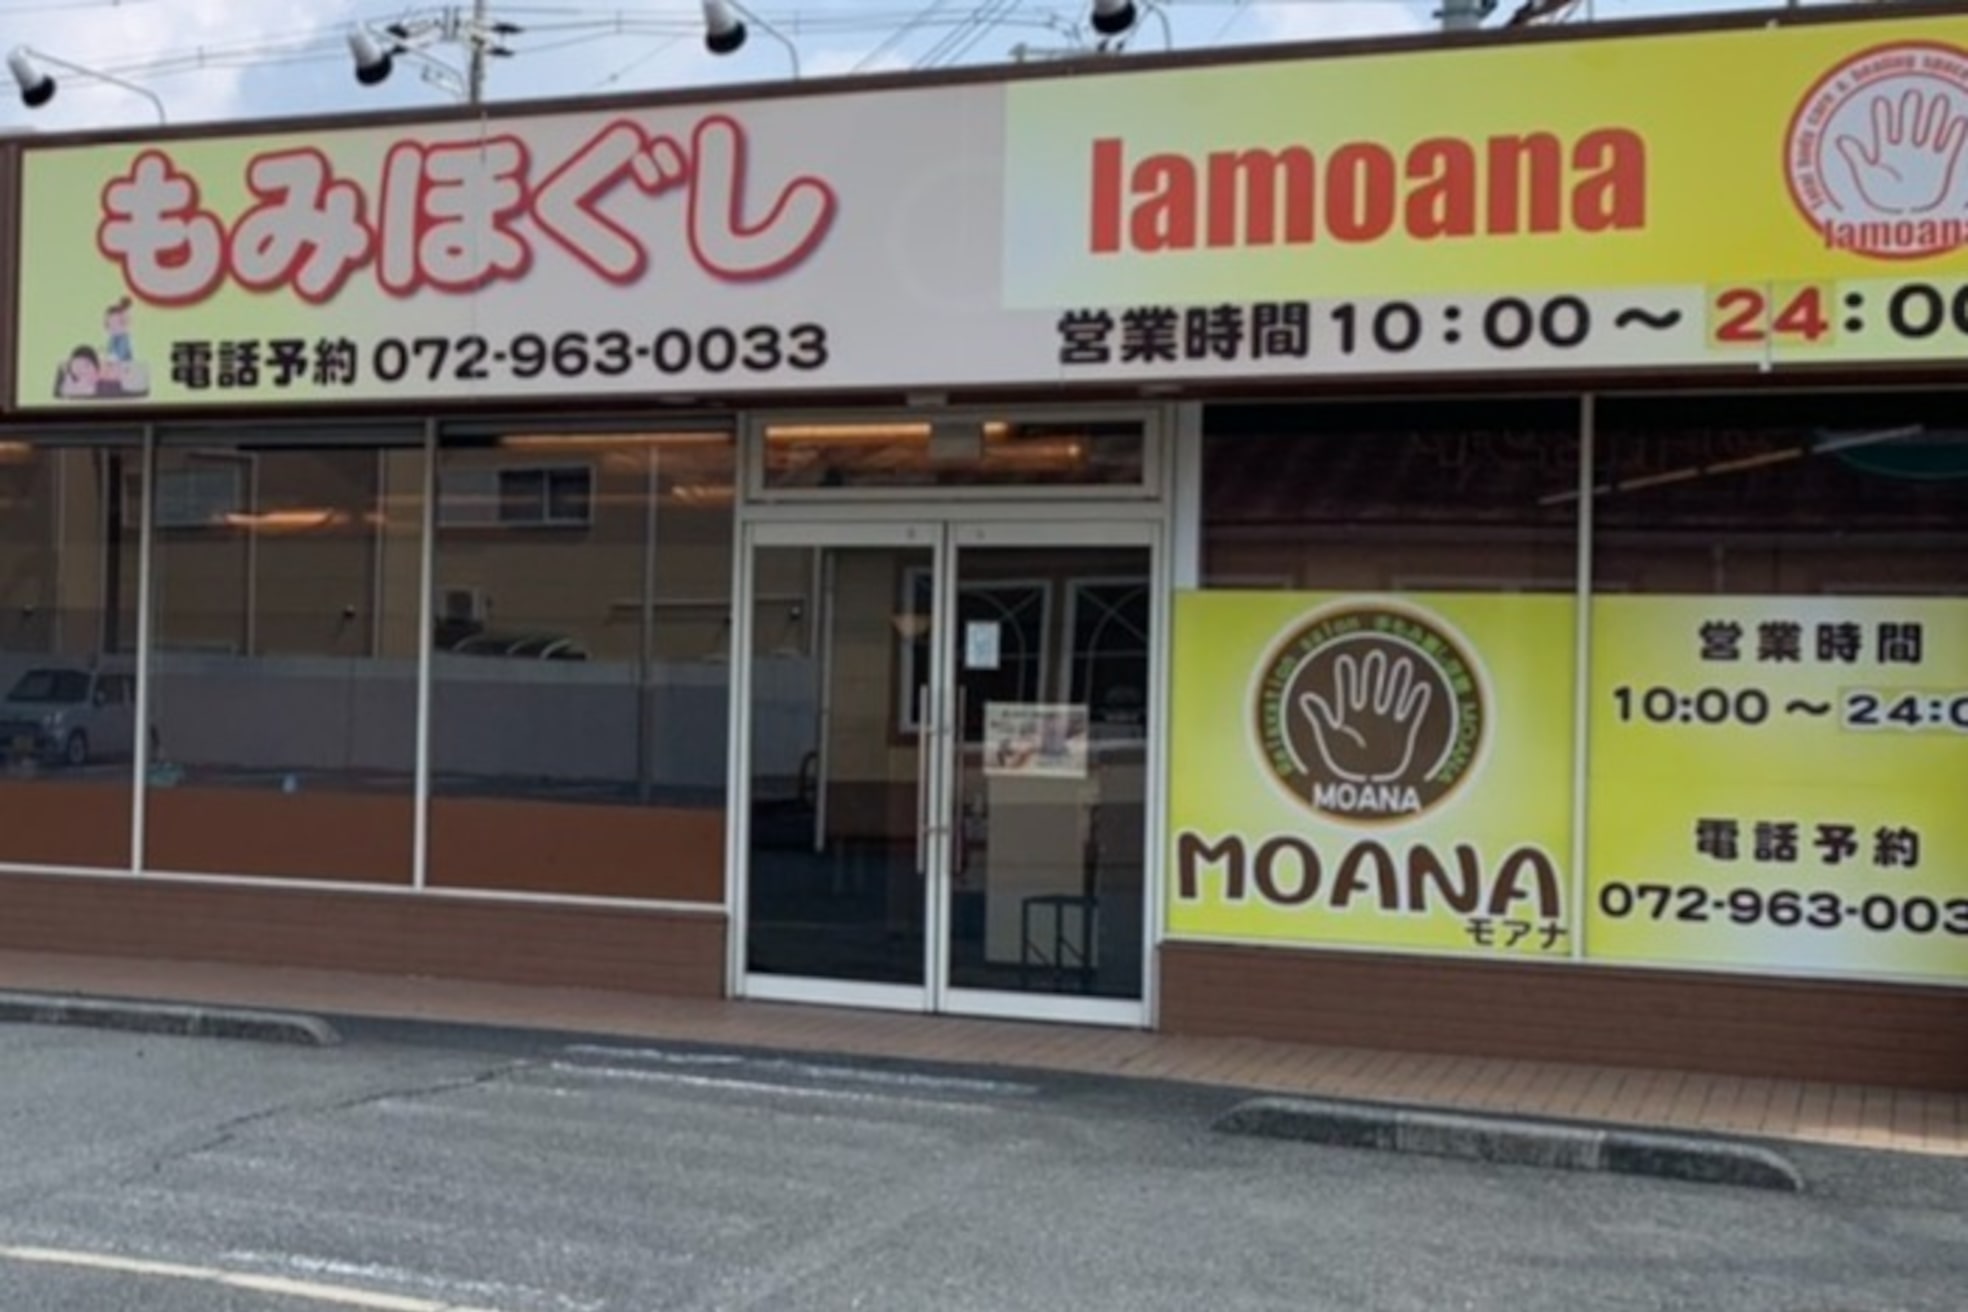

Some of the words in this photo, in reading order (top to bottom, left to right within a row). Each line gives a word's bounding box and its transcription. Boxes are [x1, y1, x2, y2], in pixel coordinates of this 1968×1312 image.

[99, 113, 835, 308] もみほぐし
[169, 337, 358, 390] 電話予約
[373, 323, 829, 382] 072-963-0033
[1057, 300, 1311, 364] 営業時間
[1698, 620, 1924, 666] 営業時間
[1612, 685, 1770, 725] 10:00
[1313, 783, 1422, 814] MOANA
[1695, 817, 1920, 869] 電話予約
[1177, 831, 1560, 920] MOANA
[1465, 918, 1569, 950] モアナ
